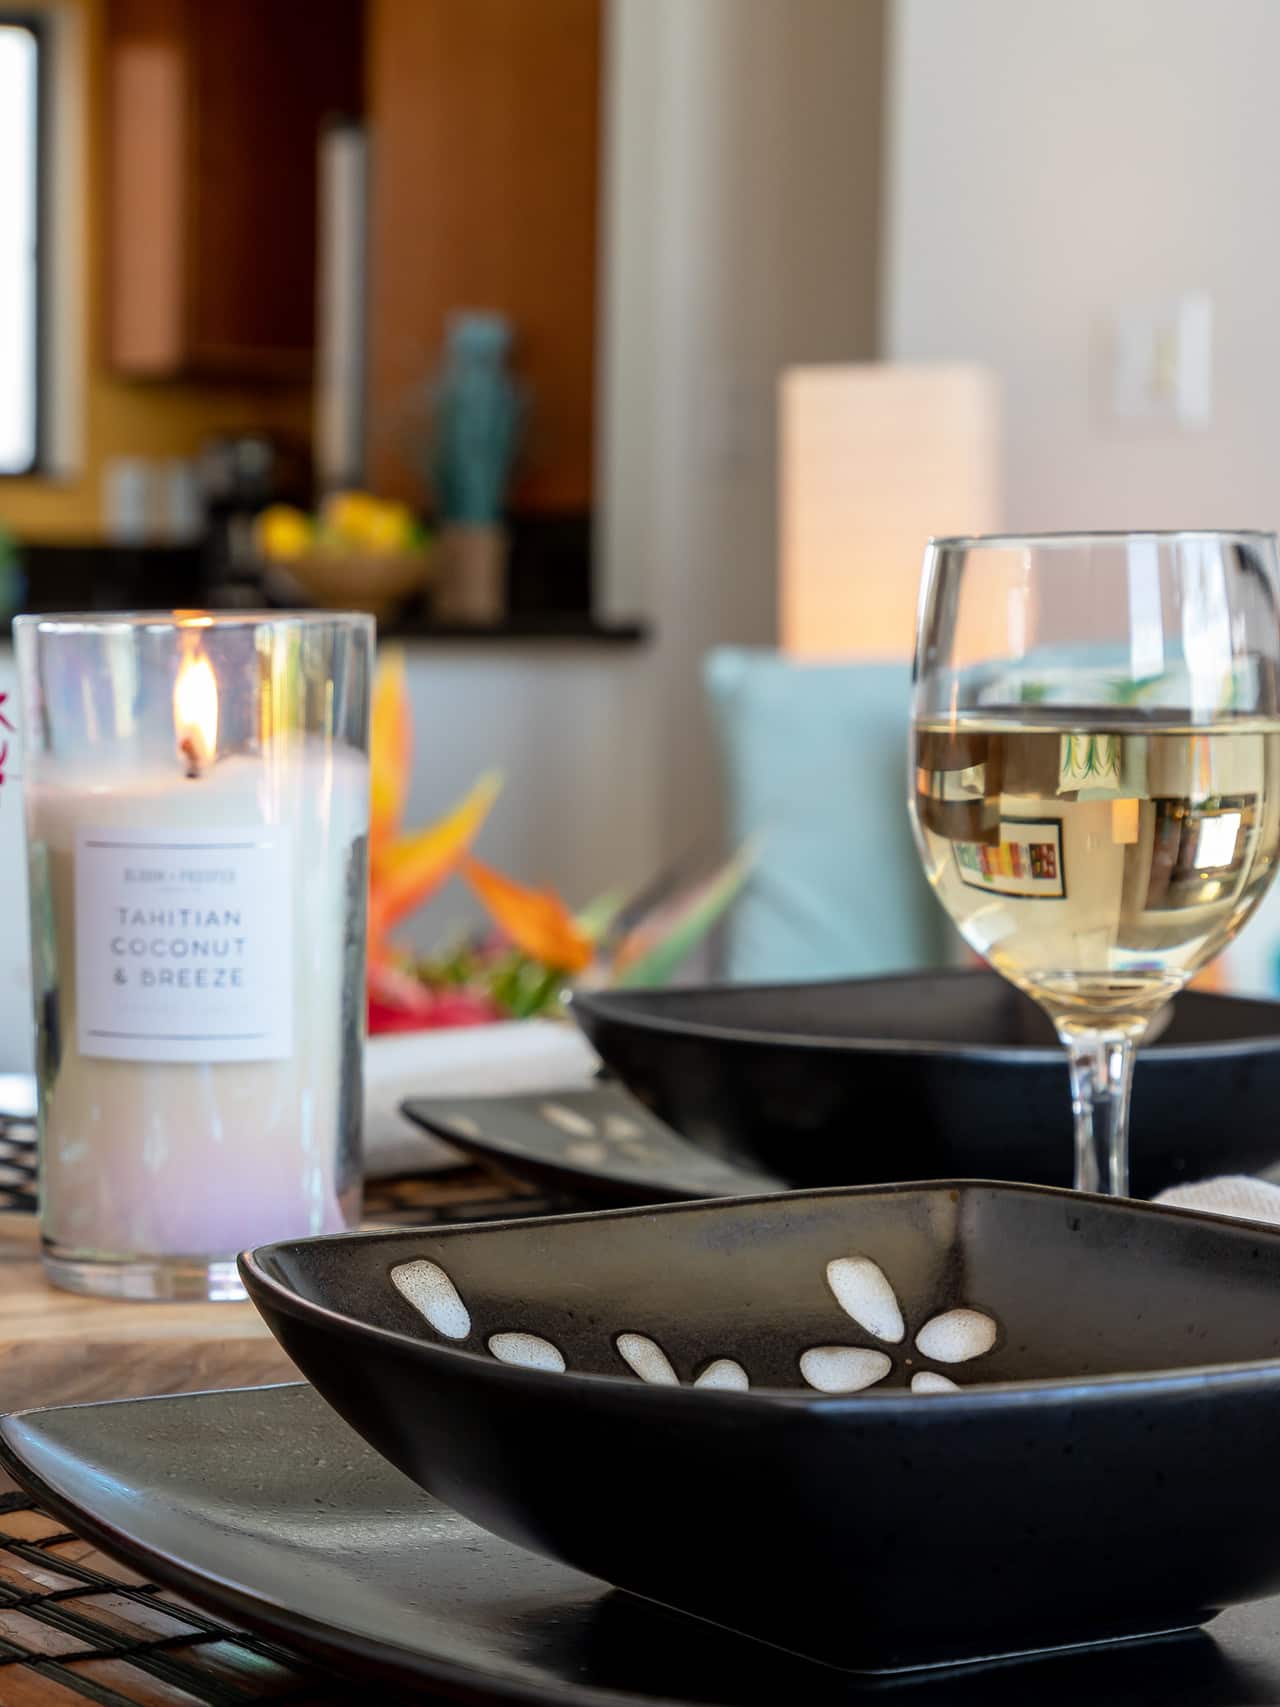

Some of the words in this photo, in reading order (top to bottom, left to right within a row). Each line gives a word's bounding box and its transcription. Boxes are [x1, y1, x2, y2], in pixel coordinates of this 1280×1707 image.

[119, 908, 241, 927] TAHITIAN
[111, 938, 246, 958] COCONUT
[113, 967, 128, 985] &
[141, 968, 243, 987] BREEZE
